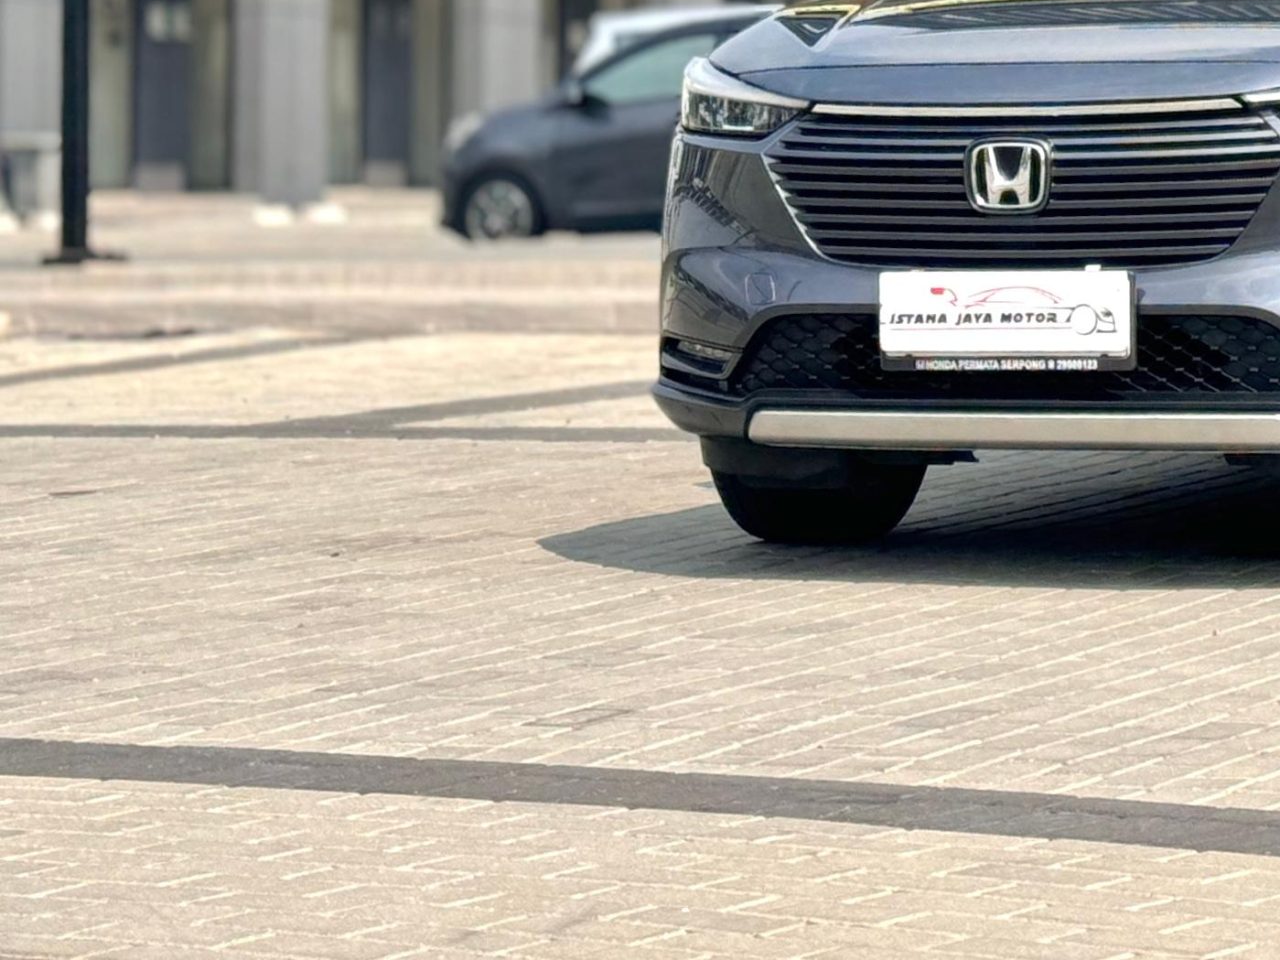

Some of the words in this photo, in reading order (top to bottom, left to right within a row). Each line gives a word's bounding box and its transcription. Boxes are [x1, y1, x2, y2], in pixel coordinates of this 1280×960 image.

[889, 312, 948, 325] ISTANA
[955, 312, 993, 326] JAYA
[1000, 312, 1058, 324] MOTOR
[926, 359, 958, 371] HONDA
[958, 359, 1000, 371] PERMATA
[1000, 359, 1046, 371] SERPONG
